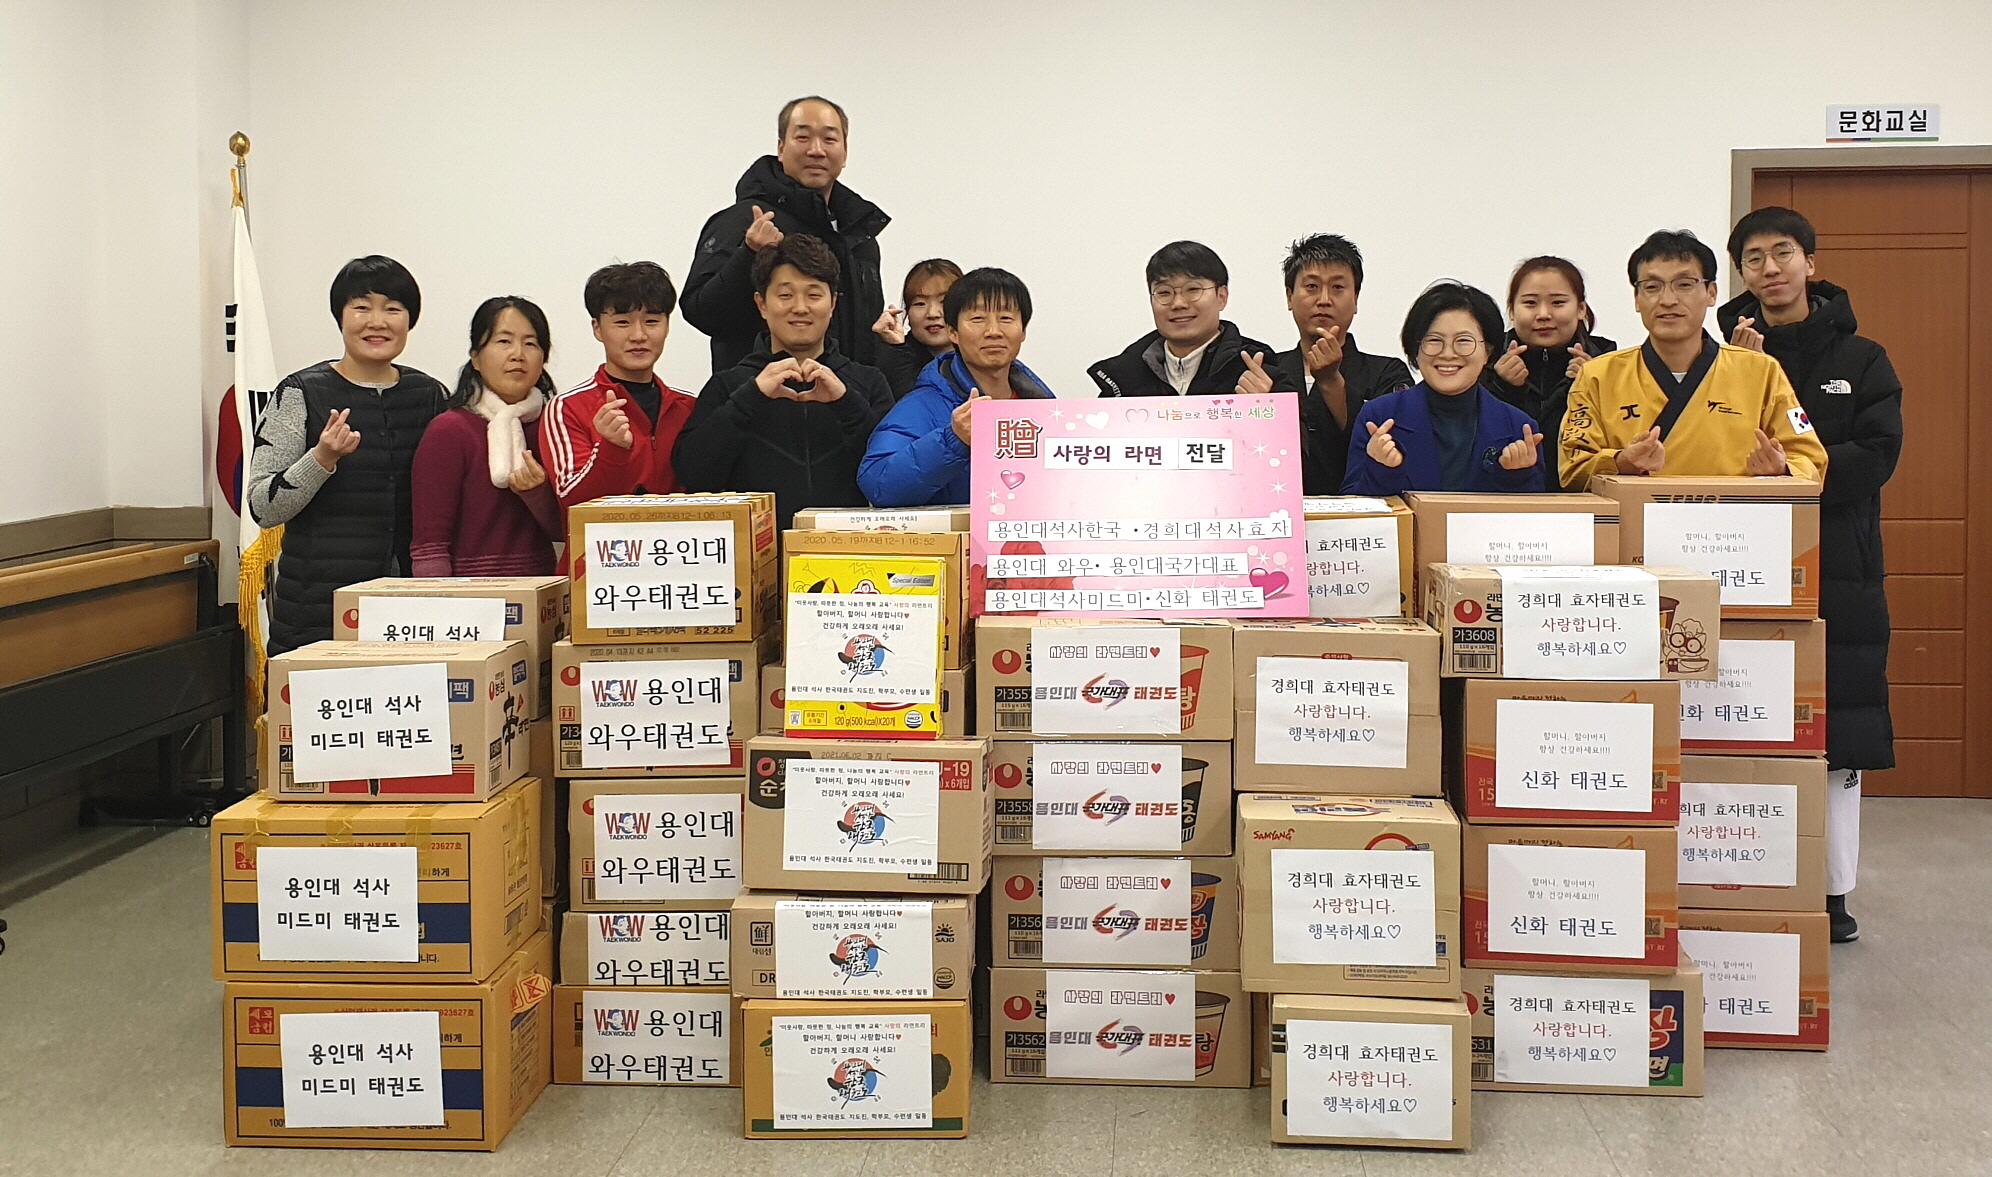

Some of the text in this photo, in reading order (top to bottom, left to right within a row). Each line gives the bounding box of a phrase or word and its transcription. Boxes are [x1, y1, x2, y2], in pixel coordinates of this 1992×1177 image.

[1839, 110, 1926, 133] 문화교실
[1156, 405, 1275, 422] 나눔으로 행복한 세상
[1053, 444, 1225, 465] 사랑의 라면 전달
[993, 520, 1121, 538] 용인대석사한국
[648, 538, 726, 566] 용인대
[1317, 537, 1386, 552] 효자태권도
[993, 559, 1045, 576] 용인대
[1110, 557, 1239, 575] 용인대국가대표
[1307, 561, 1364, 577] 랑합니다.
[891, 577, 912, 585] Special
[593, 583, 729, 611] 와우태권도
[1203, 589, 1257, 606] 태권도
[1518, 593, 1645, 608] 경희대 효자태권도
[871, 611, 903, 619] 사랑합니다
[383, 625, 480, 641] 용인대 석사
[1542, 617, 1621, 632] 사랑합니다.
[1454, 629, 1495, 642] 가3608
[1050, 646, 1147, 658] 사랑의 라면트리
[642, 677, 721, 705] 용인대
[1035, 687, 1077, 700] 용인대
[1134, 687, 1177, 699] 태권도
[1272, 679, 1395, 696] 경희대 효자태권도
[317, 695, 421, 720] 용인대 석사
[1294, 704, 1370, 720] 사랑합니다.
[1715, 705, 1768, 722] 태권도
[311, 729, 432, 750] 미드미 태권도
[588, 722, 723, 751] 와우태권도
[1051, 762, 1148, 774] 사랑의 라면트리
[871, 778, 904, 786] 사랑합니다
[1522, 771, 1627, 790] 신화 태권도
[1036, 803, 1078, 815] 용인대
[1135, 803, 1178, 816] 태권도
[1679, 802, 1784, 818] 희대 효자태권도
[656, 811, 733, 838] 용인대
[1687, 825, 1760, 840] 사랑합니다.
[1252, 827, 1296, 841] SAMYANG
[601, 856, 736, 884] 와우태권도
[285, 878, 390, 898] 용인대 석사
[1061, 876, 1158, 890] 사랑의 라면트리
[1288, 872, 1420, 889] 경희대 효자태권도
[1313, 898, 1395, 914] 사랑합니다.
[278, 912, 400, 932] 미드미 태권도
[649, 913, 727, 941] 용인대
[1046, 916, 1088, 930] 용인대
[1145, 918, 1188, 931] 태권도
[1511, 916, 1617, 937] 신화 태권도
[594, 958, 730, 986] 와우태권도
[1064, 990, 1162, 1005] 사랑의 라면트리
[1510, 997, 1636, 1014] 경희대 효자태권도
[1719, 998, 1772, 1015] 태권도
[644, 1010, 722, 1038] 용인대
[1533, 1022, 1611, 1038] 사랑합니다.
[803, 1034, 832, 1042] 할아버지,
[860, 1033, 895, 1041] 사랑합니다
[1007, 1033, 1045, 1046] 가3562
[1049, 1032, 1092, 1044] 용인대
[1149, 1033, 1192, 1047] 태권도
[309, 1043, 413, 1065] 용인대 석사
[1303, 1044, 1438, 1063] 경희대 효자태권도
[587, 1054, 723, 1082] 와우태권도
[302, 1077, 424, 1097] 미드미 태권도
[1328, 1070, 1411, 1088] 사랑합니다.
